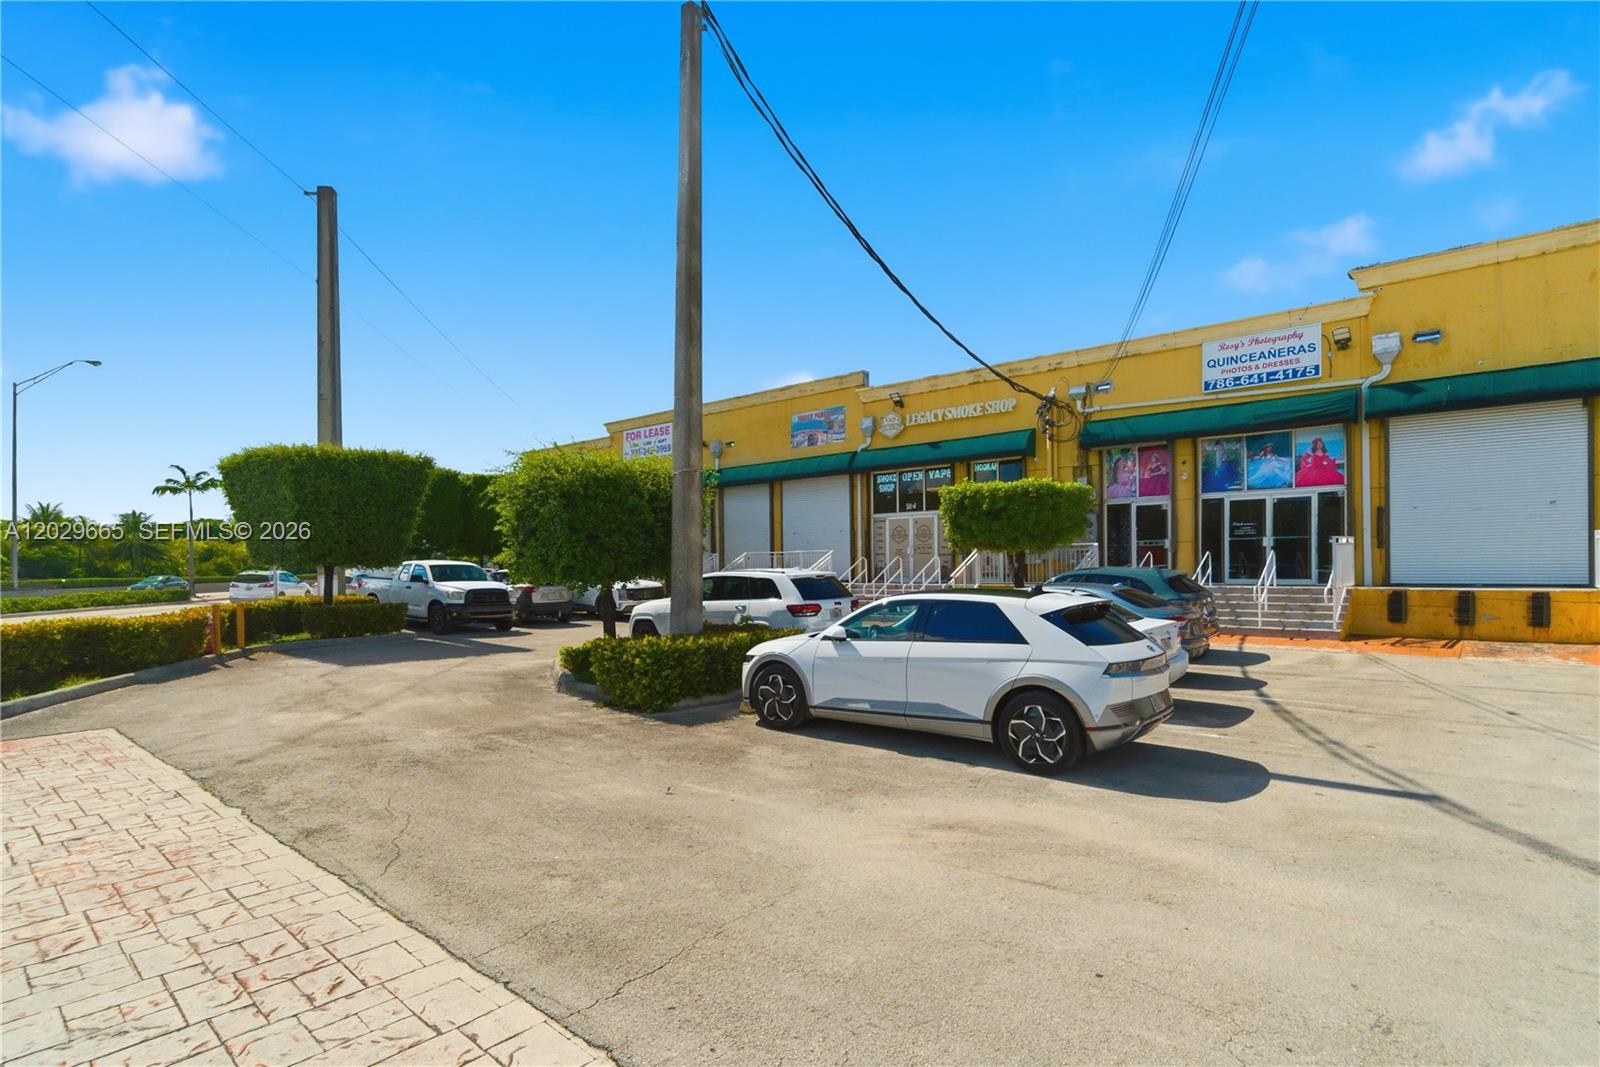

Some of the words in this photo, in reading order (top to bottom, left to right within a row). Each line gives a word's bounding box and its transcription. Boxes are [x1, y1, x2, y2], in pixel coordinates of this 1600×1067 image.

[1218, 340, 1245, 351] Rosy's
[1248, 331, 1304, 346] Photography
[1207, 343, 1316, 368] QUINCEAÑERAS
[1221, 364, 1252, 375] PHOTOS
[1262, 358, 1300, 369] DRESSES
[1207, 366, 1316, 390] 786-641-4175
[906, 409, 945, 426] LEGACY
[944, 403, 984, 420] SMOKE
[984, 398, 1016, 415] SHOP
[625, 431, 641, 442] FOR
[644, 425, 670, 438] LEASE
[902, 471, 923, 482] OPEN
[929, 468, 951, 479] VAPE
[879, 483, 895, 493] SHOP
